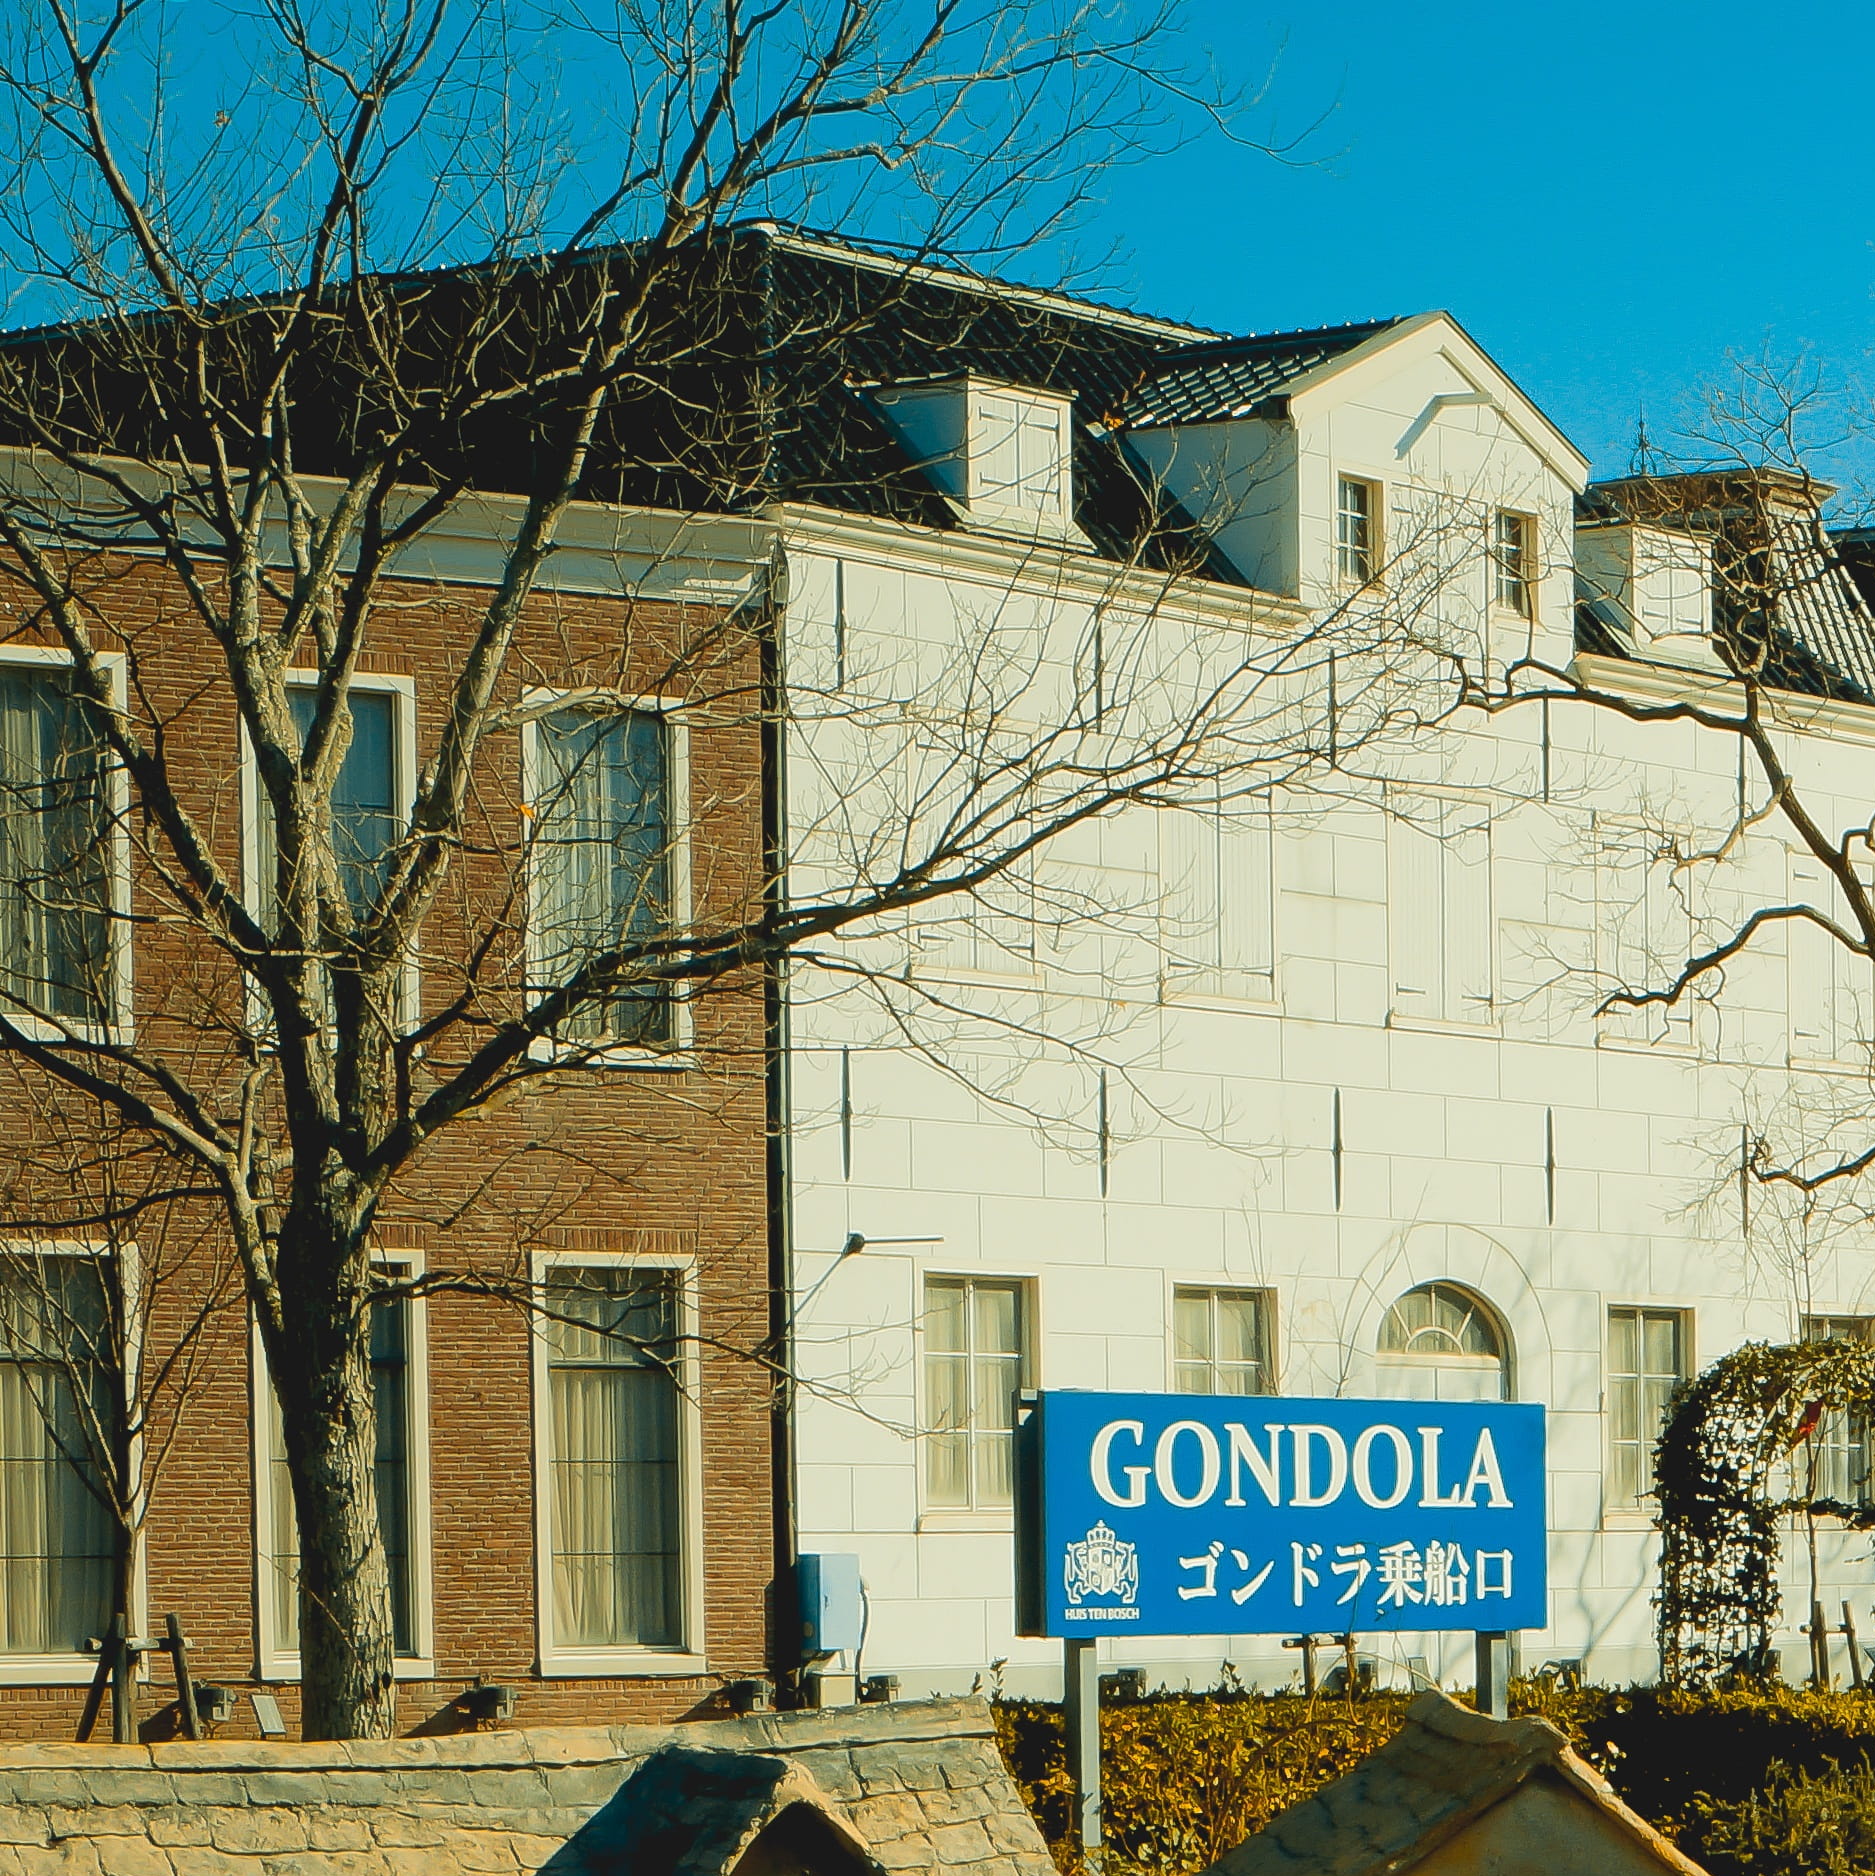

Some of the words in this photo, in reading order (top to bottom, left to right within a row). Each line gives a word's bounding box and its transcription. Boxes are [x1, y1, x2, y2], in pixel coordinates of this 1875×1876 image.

[1089, 1419, 1514, 1508] GONDOLA
[1177, 1538, 1513, 1608] ゴンドラ乗船口
[1065, 1608, 1087, 1620] HUIS
[1088, 1608, 1107, 1620] TEN
[1108, 1608, 1140, 1620] BOSCH
